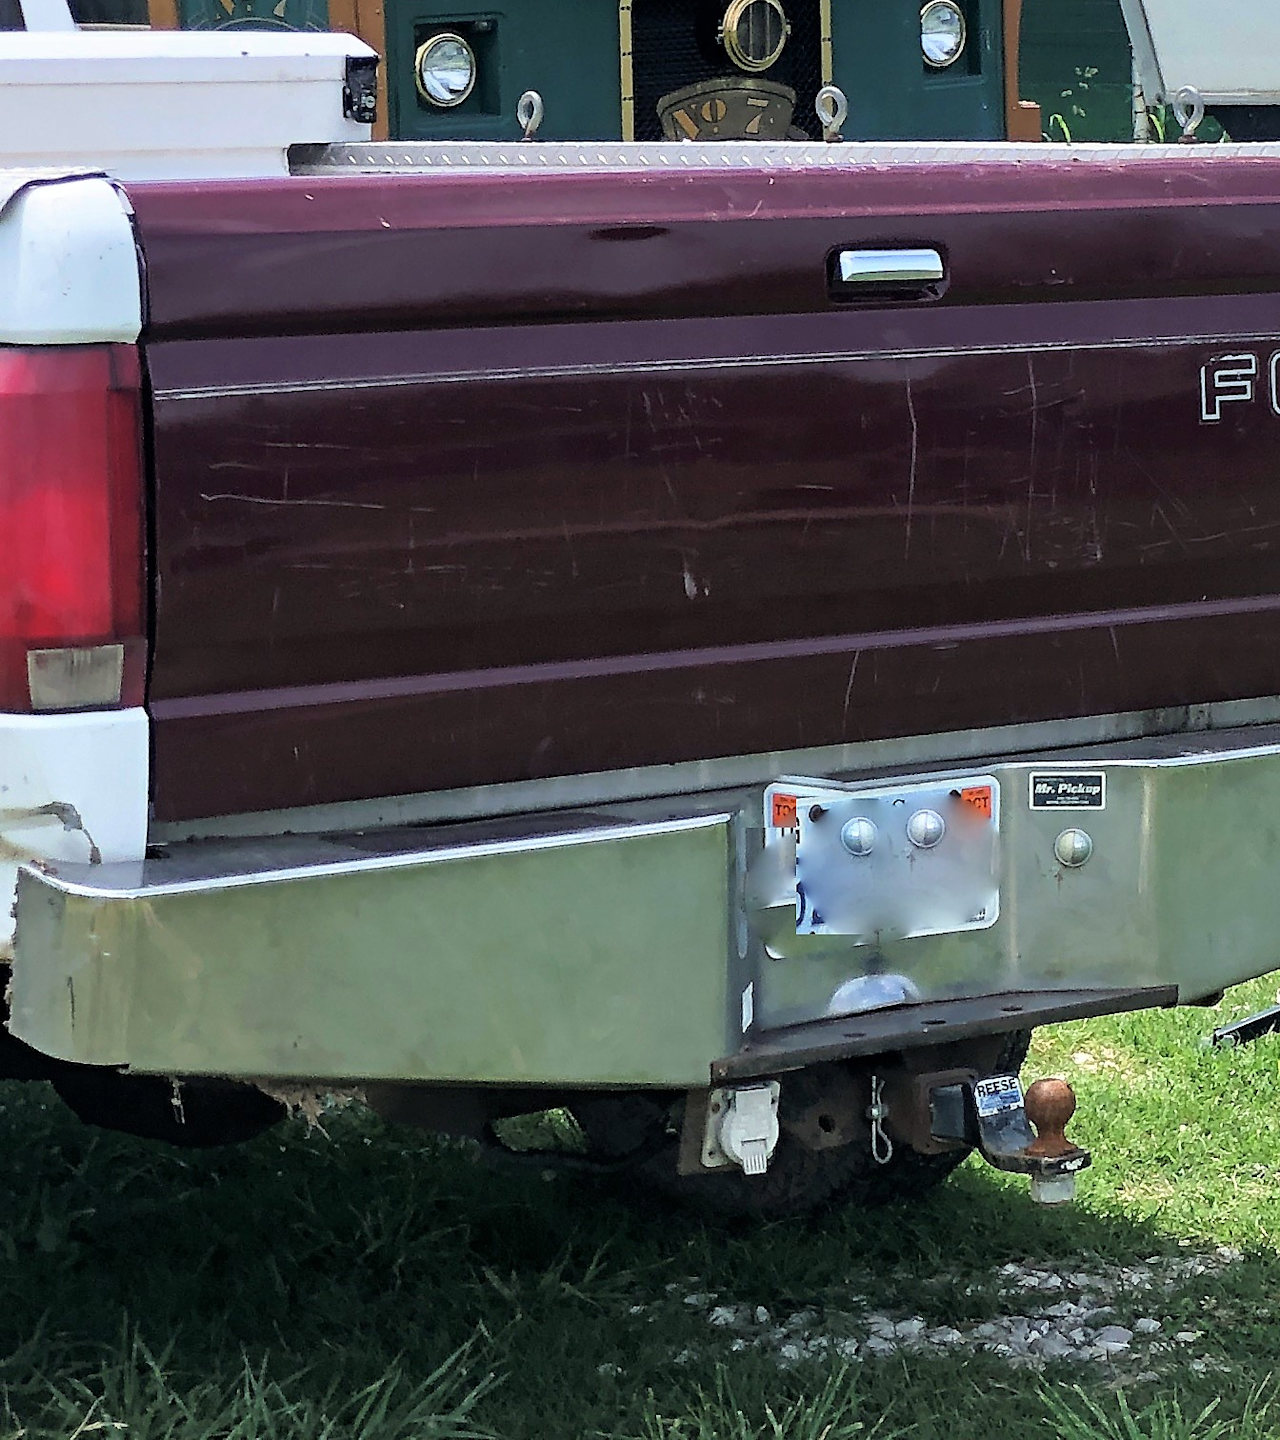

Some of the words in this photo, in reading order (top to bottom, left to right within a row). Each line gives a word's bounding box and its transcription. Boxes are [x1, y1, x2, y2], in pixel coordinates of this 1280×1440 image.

[745, 97, 770, 134] 7
[1035, 783, 1056, 794] Mr.
[1058, 783, 1101, 796] Pickup
[977, 1078, 1018, 1099] REESE
